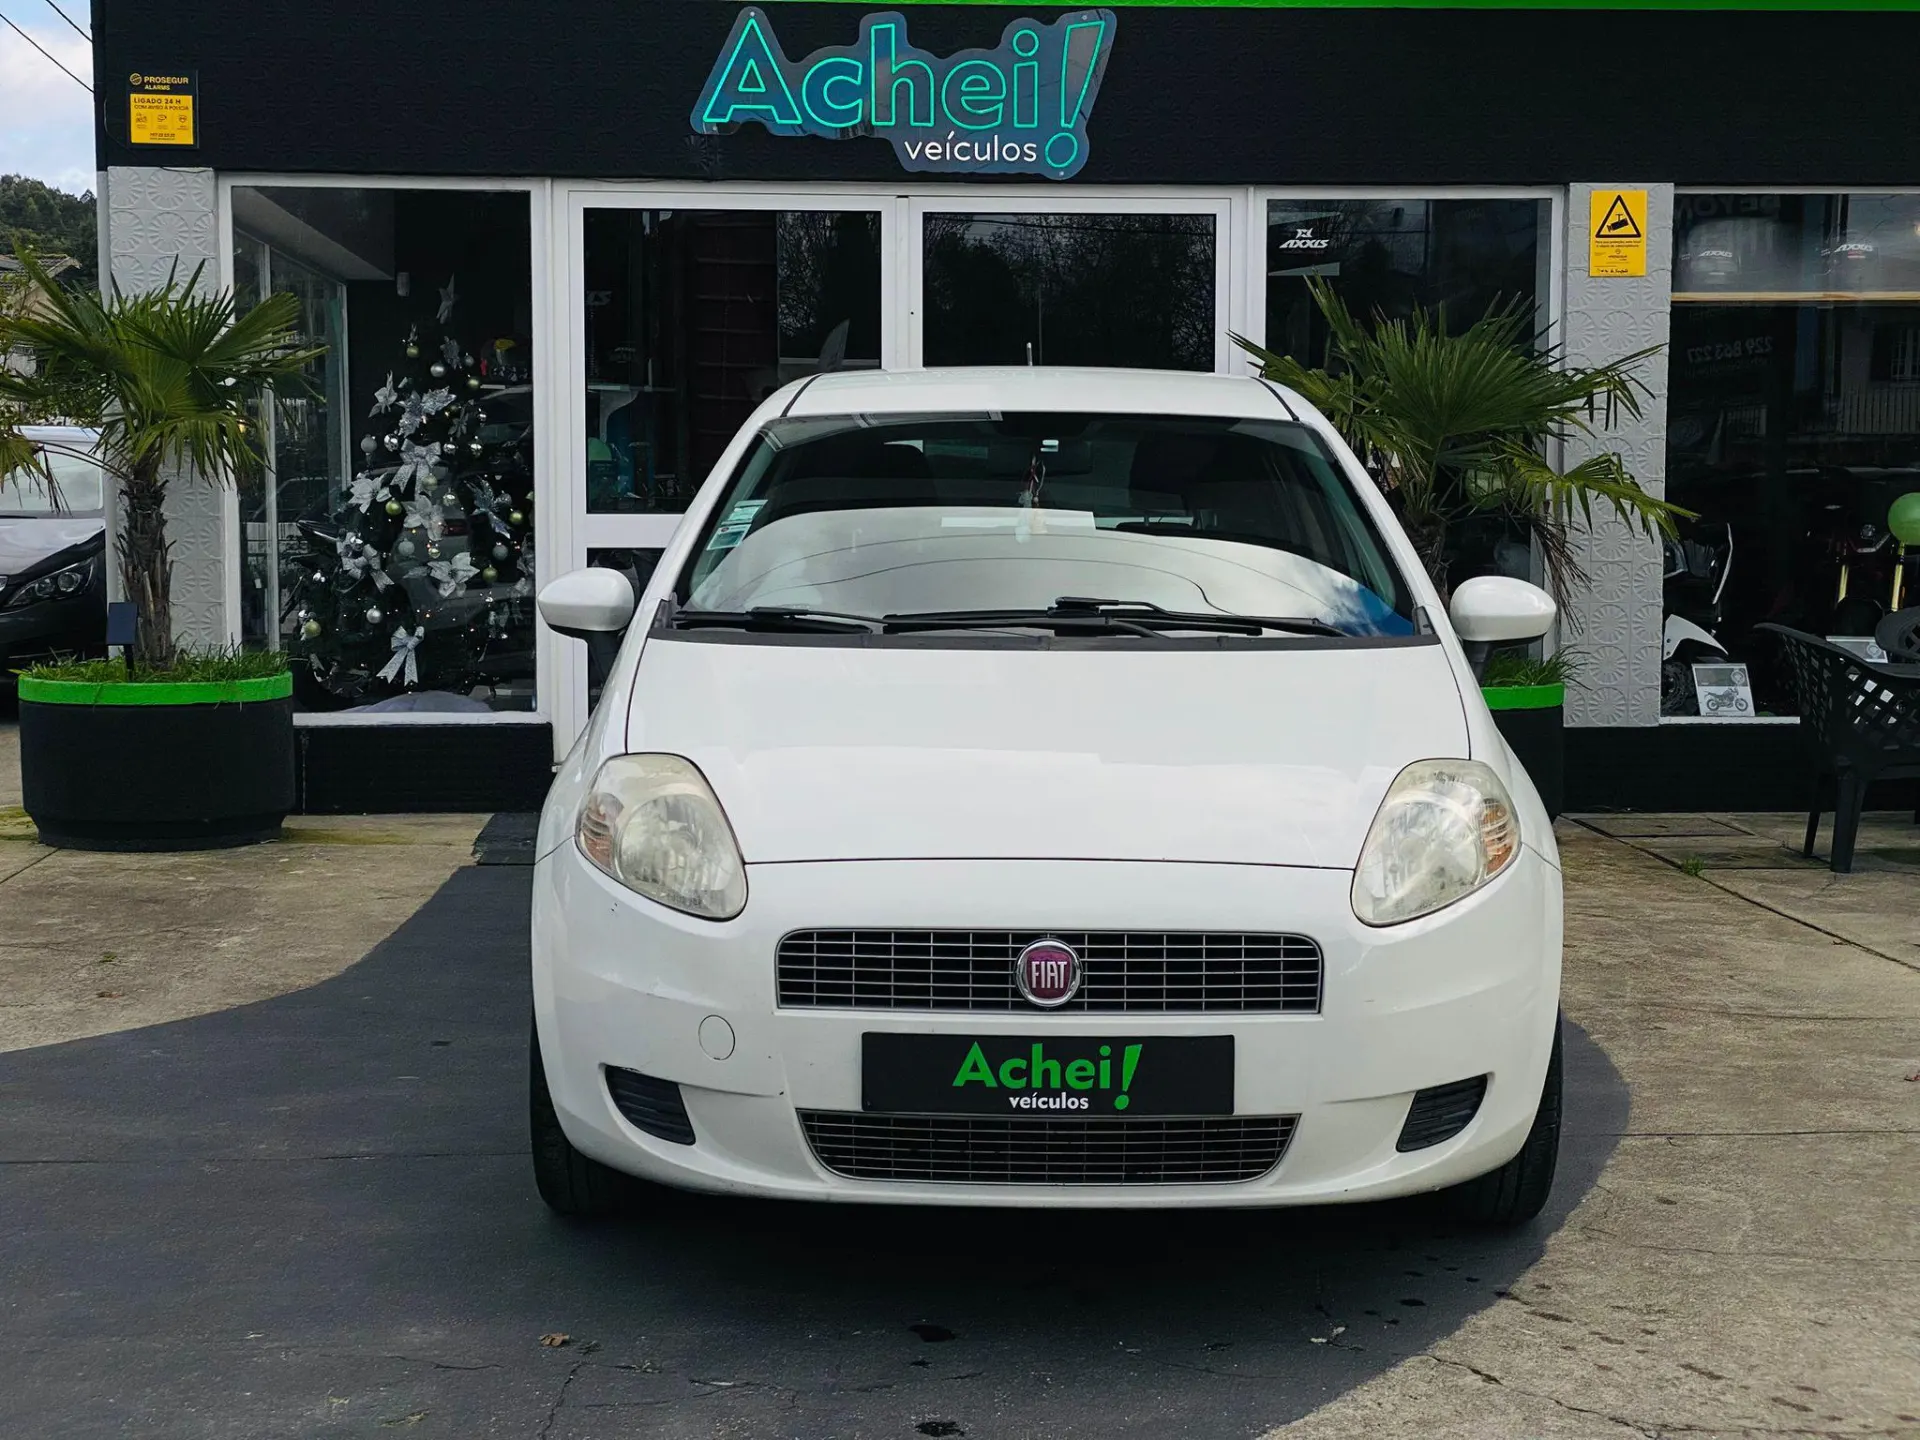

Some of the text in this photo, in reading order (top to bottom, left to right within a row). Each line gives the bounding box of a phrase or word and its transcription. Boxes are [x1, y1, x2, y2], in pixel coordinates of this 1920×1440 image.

[903, 130, 1038, 162] veículos
[1278, 239, 1330, 249] AXXIS
[1031, 961, 1068, 989] FIAT
[1008, 1092, 1089, 1110] veículos
